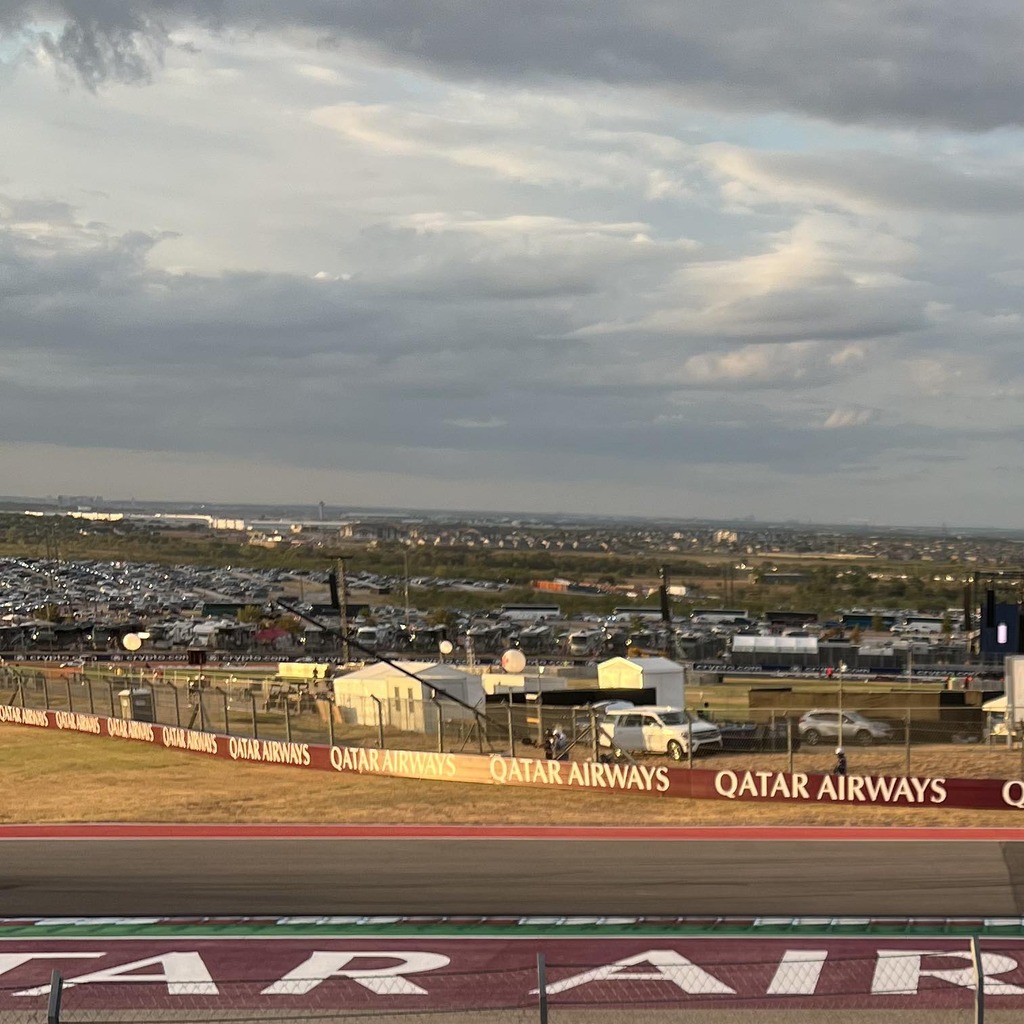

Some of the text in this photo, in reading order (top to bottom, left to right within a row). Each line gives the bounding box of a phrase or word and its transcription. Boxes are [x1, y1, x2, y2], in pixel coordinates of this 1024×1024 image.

[107, 718, 129, 738] QATAR
[162, 727, 218, 754] QATAR AIRWAYS
[229, 737, 310, 766] QATAR AIRWAYS
[331, 746, 457, 777] QATAR AIRWAYS
[490, 757, 670, 792] QATAR AIRWAYS
[715, 770, 947, 803] QATAR AIRWAYS
